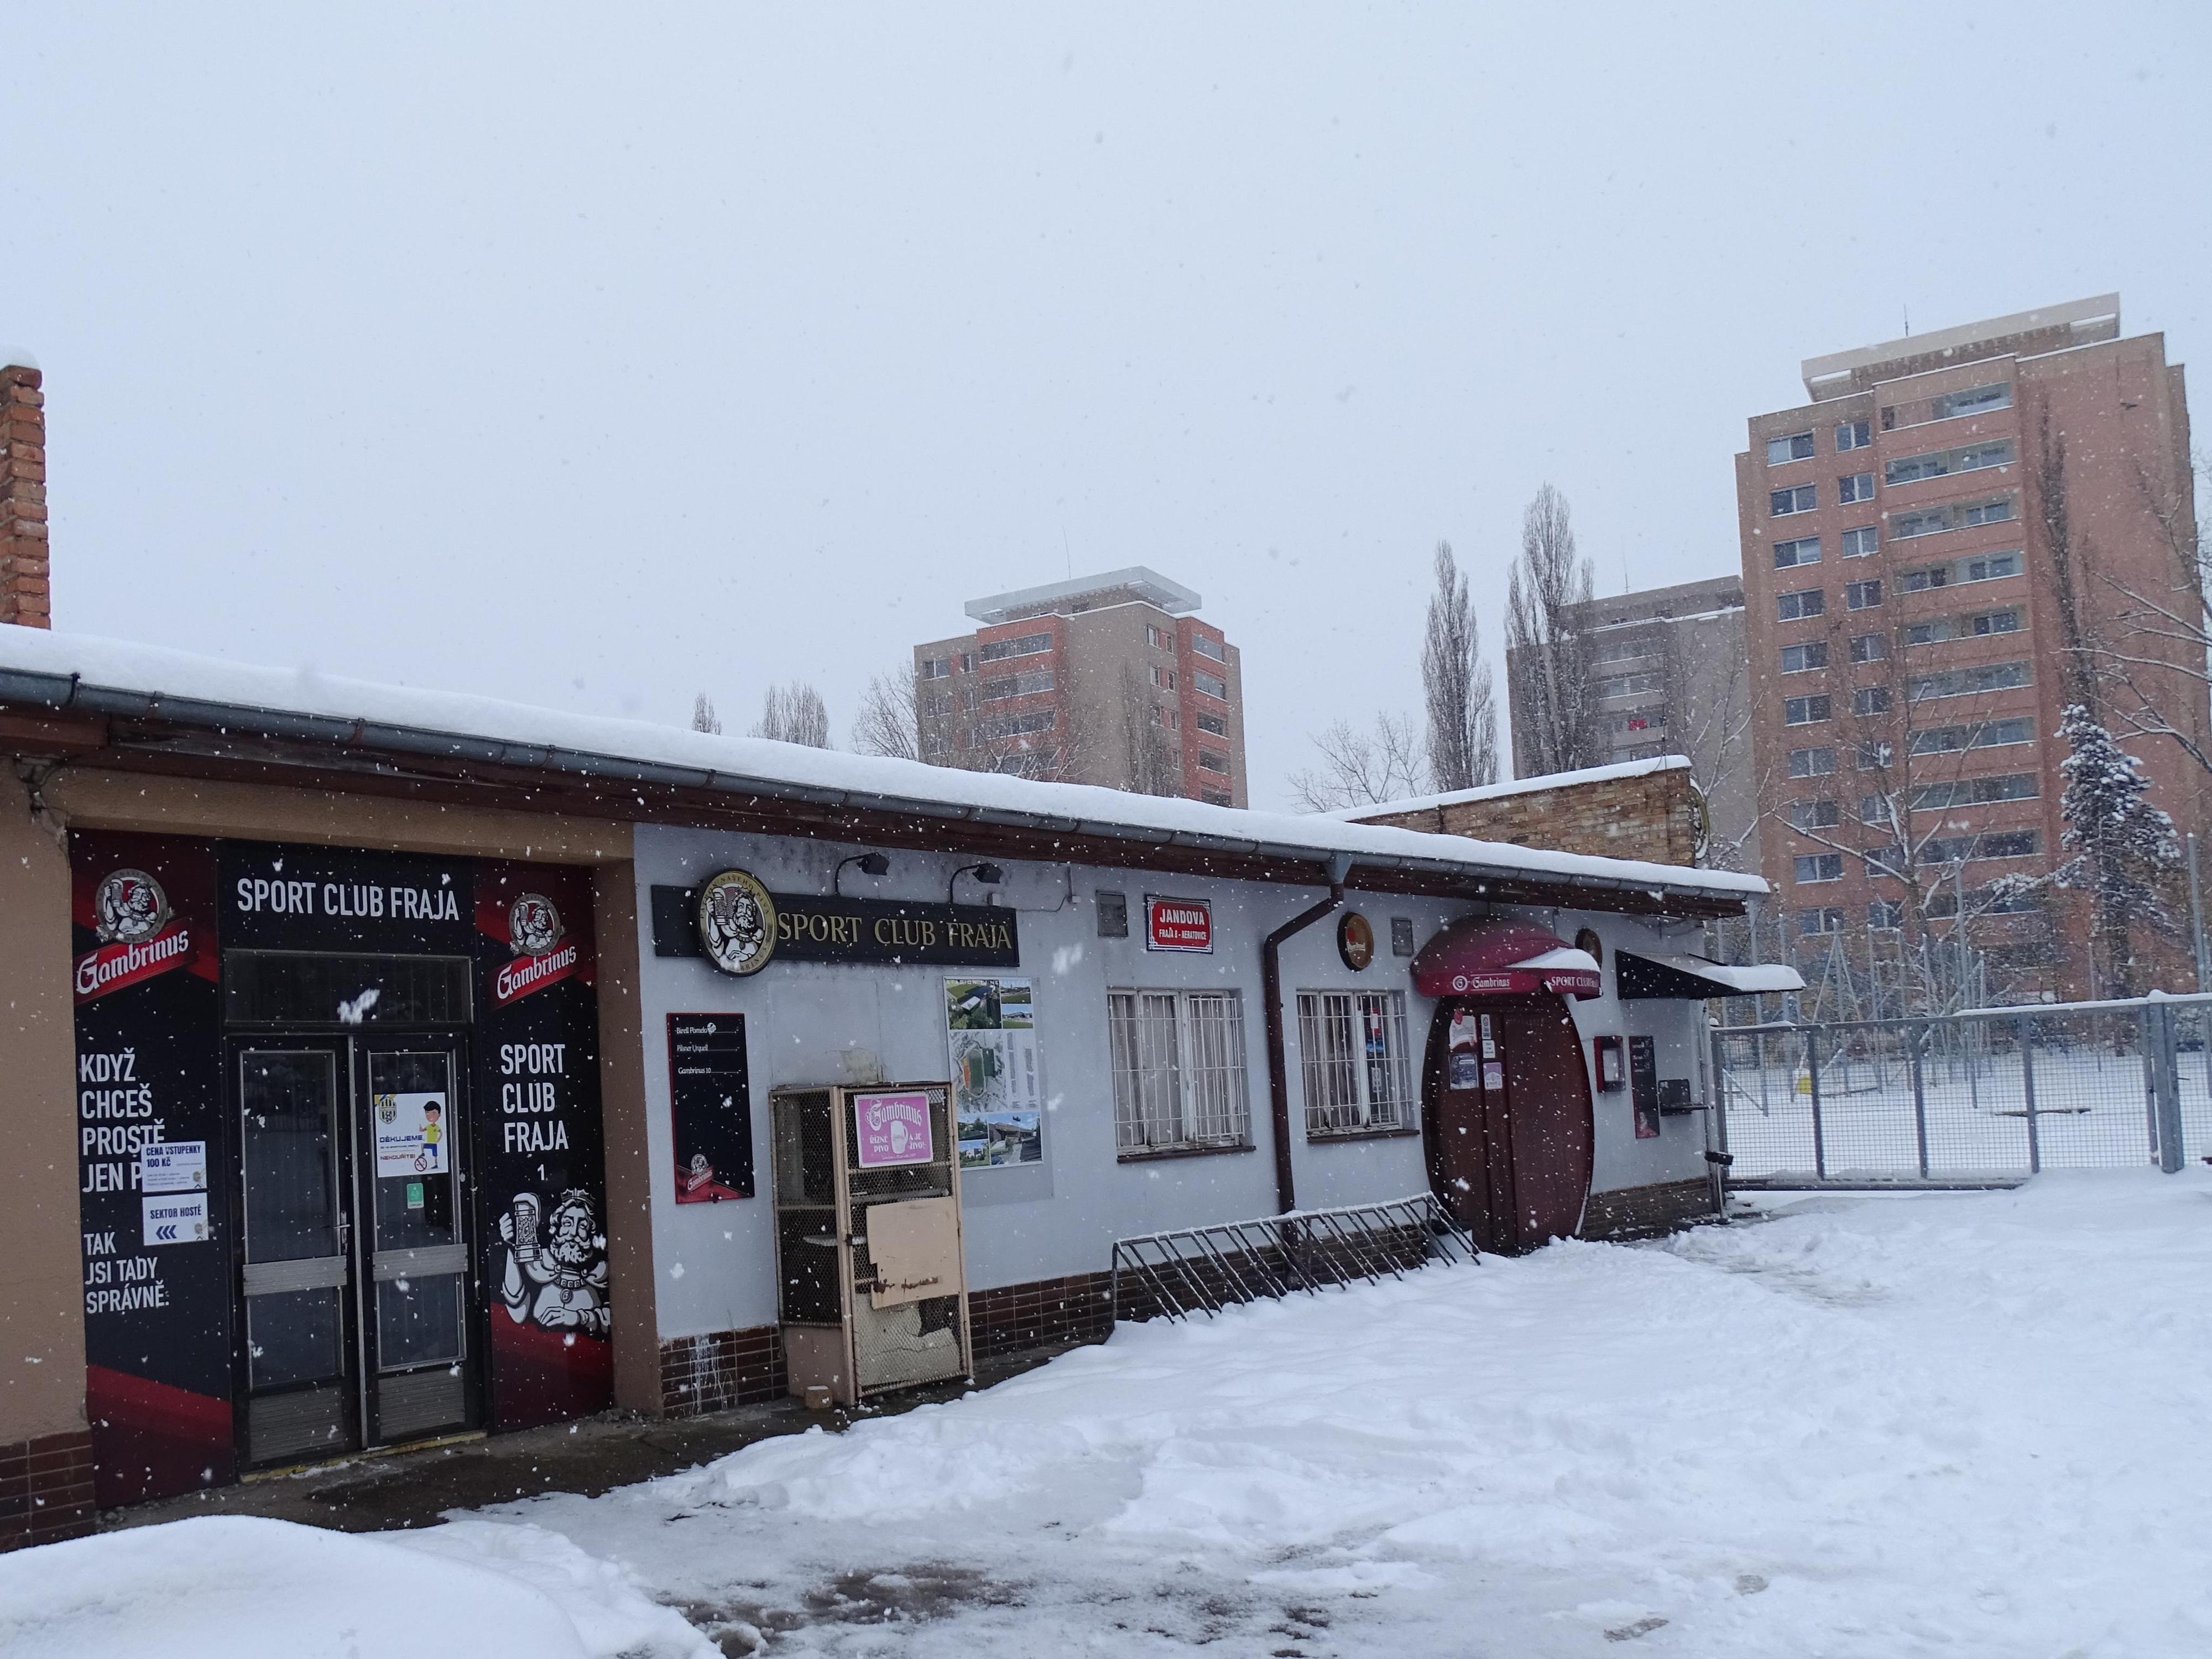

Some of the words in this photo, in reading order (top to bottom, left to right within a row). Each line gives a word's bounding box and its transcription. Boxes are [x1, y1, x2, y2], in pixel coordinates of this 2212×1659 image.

[237, 878, 316, 914] SPORT
[324, 883, 384, 917] CLUB
[390, 887, 460, 921] FRAJA
[777, 912, 862, 942] SPORT
[874, 918, 936, 946] CLUB
[946, 922, 1013, 949] FRAJA
[1160, 909, 1205, 925] JANDOVA
[76, 930, 189, 994] Gambrinus
[497, 946, 577, 999] Gambrinus
[1470, 976, 1510, 989] Gambrinus
[1551, 976, 1575, 987] SPORT
[81, 1047, 136, 1082] KDYŽ
[500, 1044, 565, 1074] SPORT
[82, 1083, 153, 1119] CHCEŠ
[502, 1082, 556, 1114] CLUB
[865, 1098, 922, 1131] Gambrinus
[82, 1118, 165, 1156] PROSTĚ
[147, 1146, 164, 1156] CENA
[165, 1145, 201, 1155] VSTUPENKY
[504, 1120, 569, 1153] FRAJA
[874, 1145, 889, 1153] PIVO
[82, 1162, 124, 1193] JEN
[146, 1159, 160, 1168] 100
[150, 1208, 178, 1219] SEKTOR
[84, 1232, 117, 1256] TAK
[84, 1260, 111, 1285] JSI
[116, 1256, 158, 1282] TADY
[86, 1279, 170, 1314] SPRÁVNĚ.
